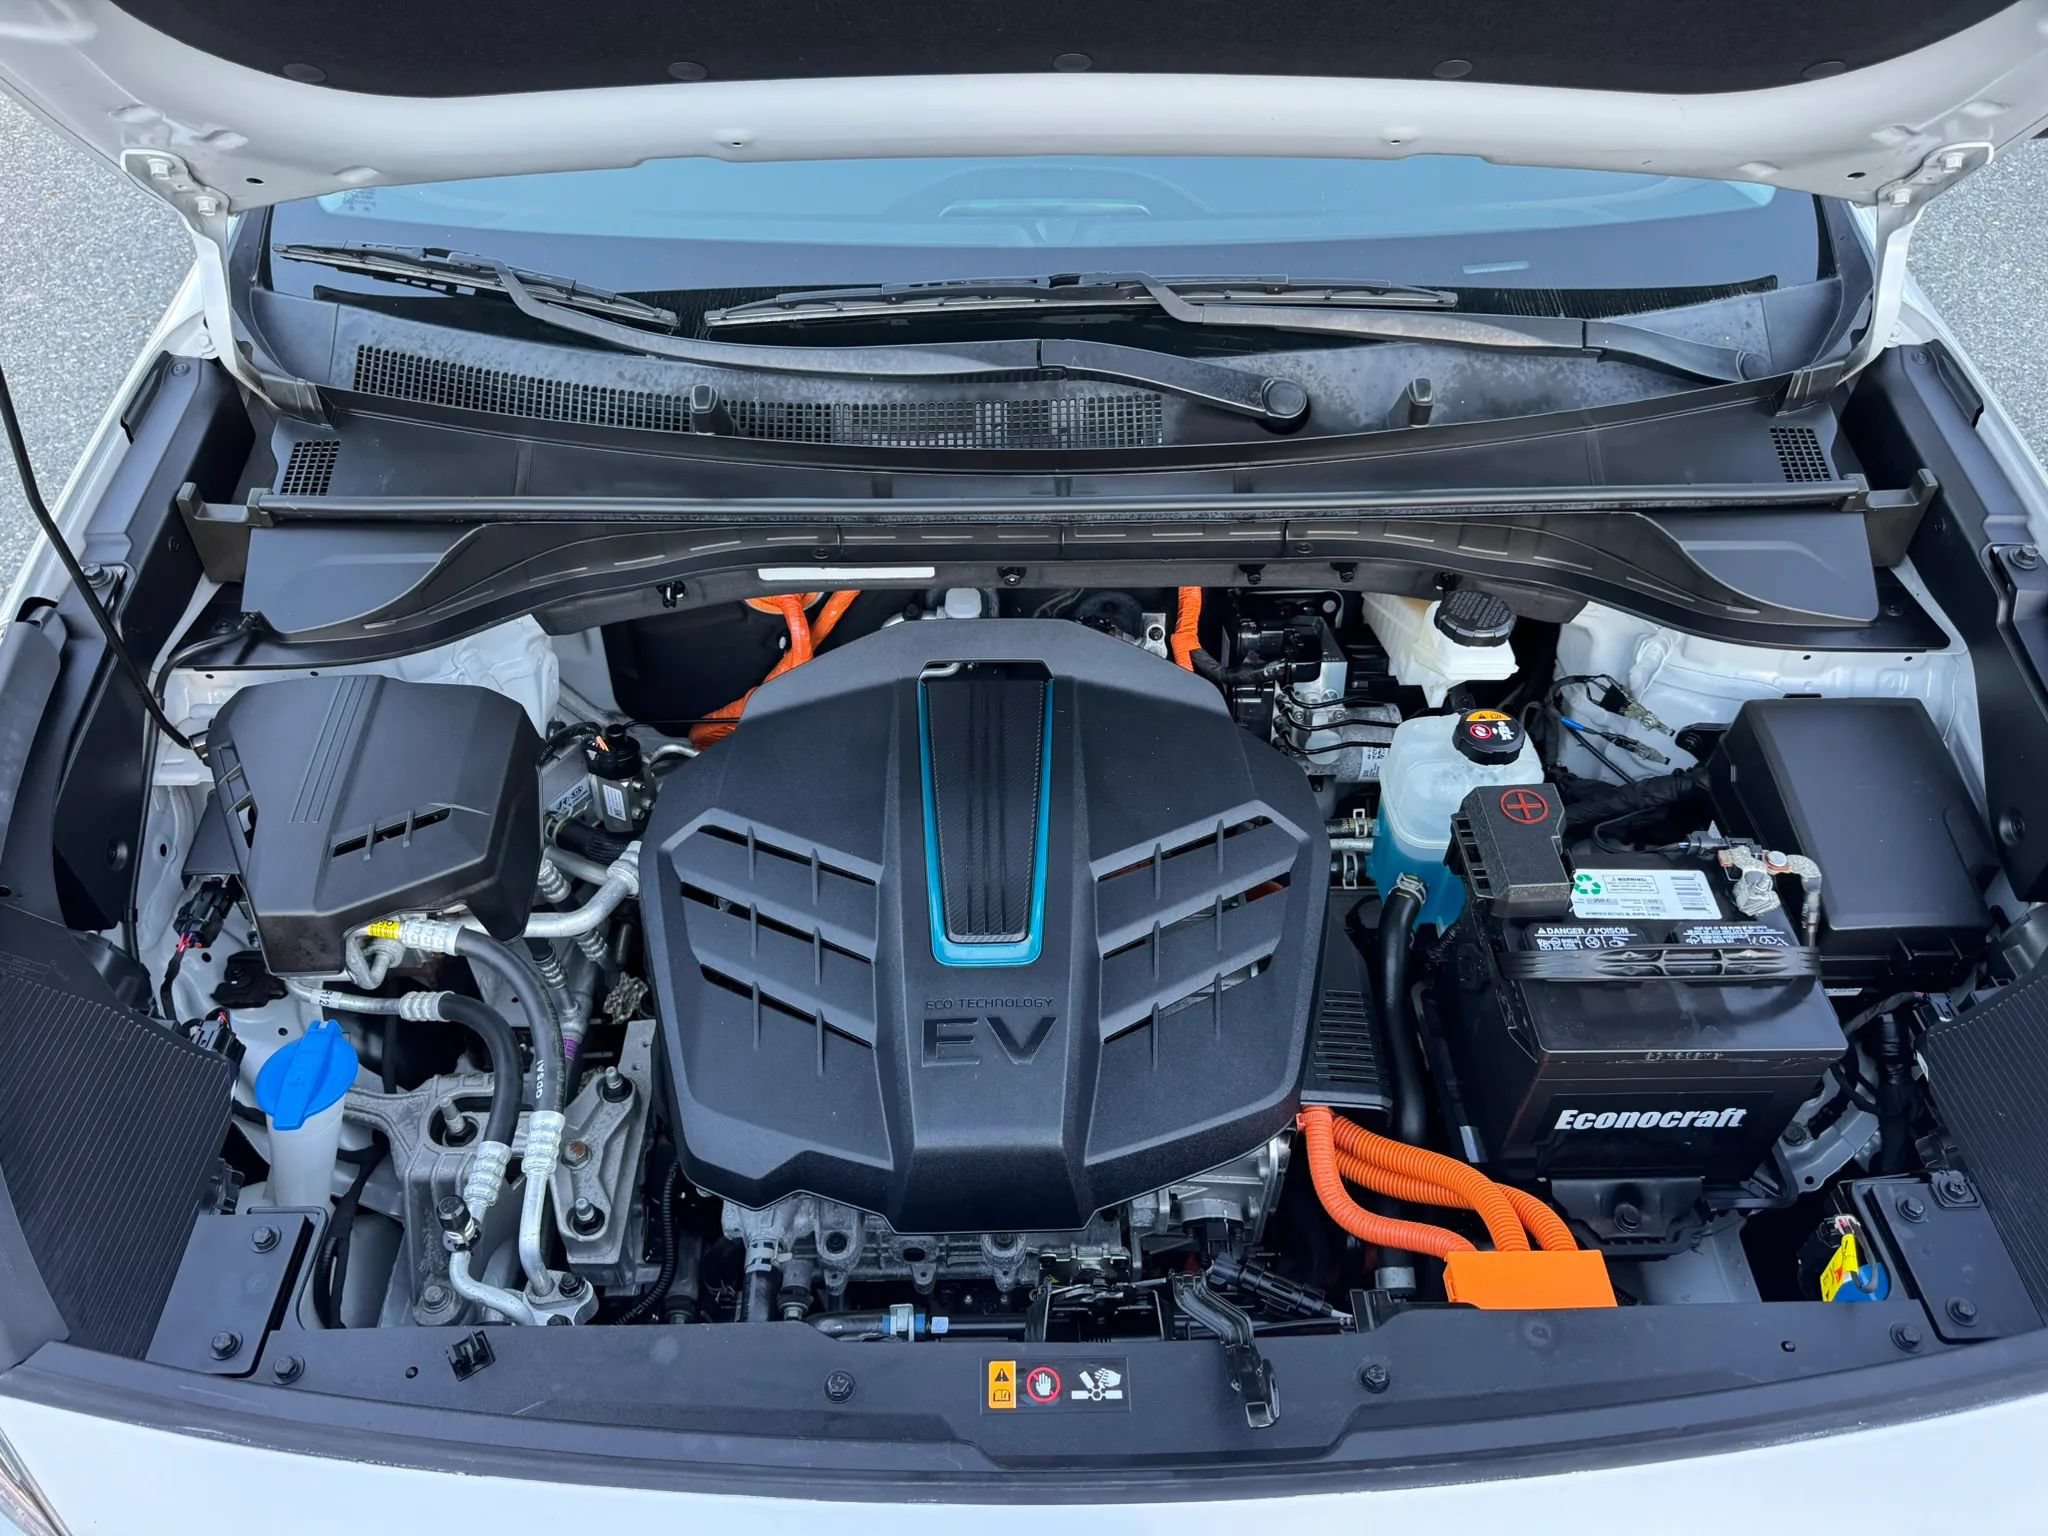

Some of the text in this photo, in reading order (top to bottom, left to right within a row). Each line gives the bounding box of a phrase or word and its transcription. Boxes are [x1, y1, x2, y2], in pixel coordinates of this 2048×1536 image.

[925, 997, 1054, 1010] ECO TECHNOLOGY
[921, 1016, 1057, 1068] EV
[1553, 1107, 1747, 1130] Econocraft
